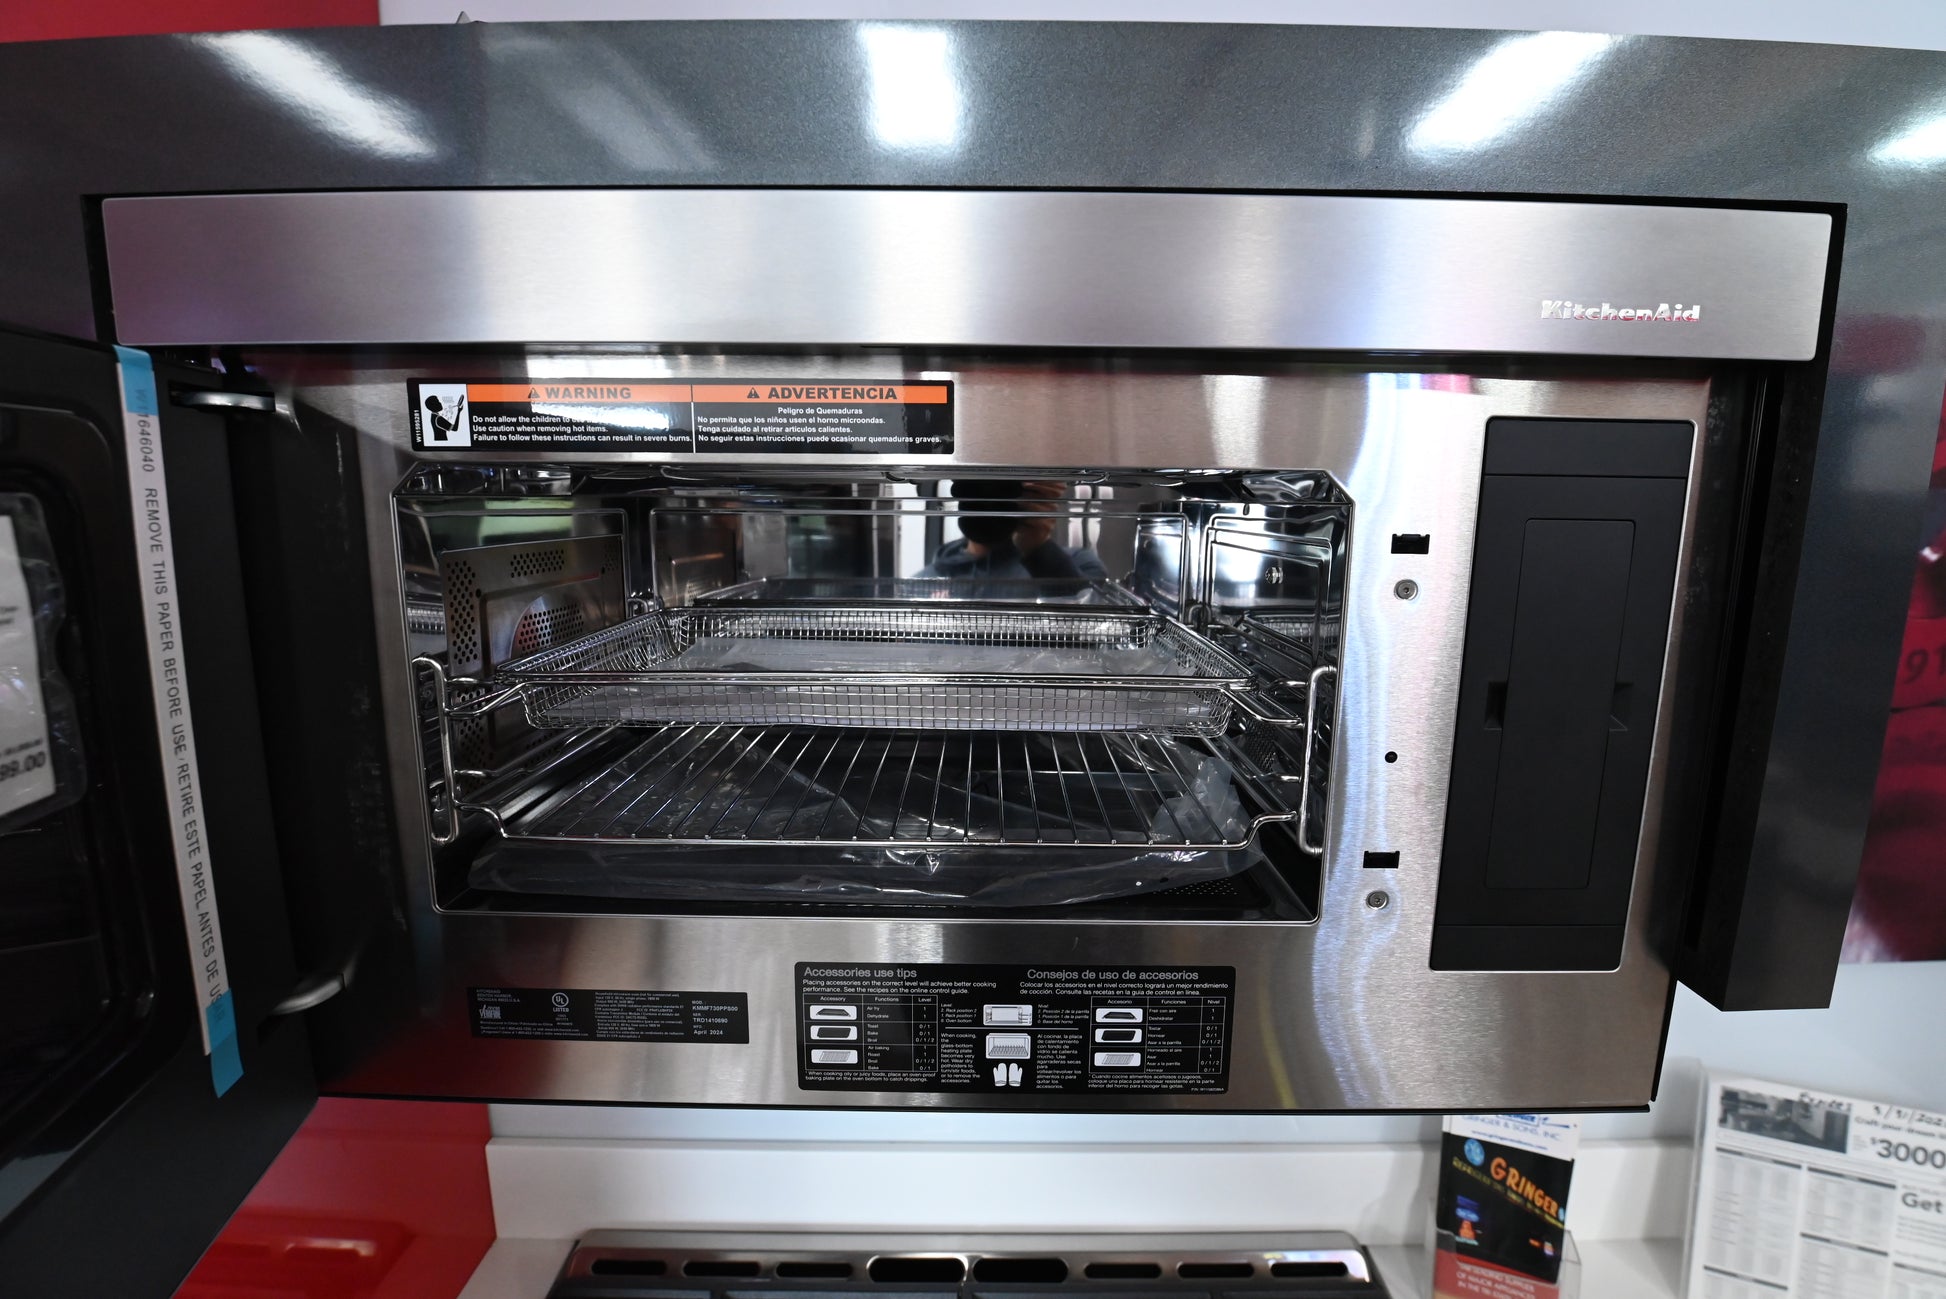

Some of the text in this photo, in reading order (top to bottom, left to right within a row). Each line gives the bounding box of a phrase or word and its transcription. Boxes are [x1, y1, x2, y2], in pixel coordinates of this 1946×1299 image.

[1541, 300, 1701, 322] KitchenAid
[545, 387, 632, 399] WARNING
[767, 387, 898, 400] ADVERTENCIA
[709, 416, 737, 425] permita
[777, 407, 804, 415] Peligro
[816, 407, 863, 416] Quemaduras
[537, 425, 571, 434] removing
[698, 426, 720, 434] Tenga
[710, 434, 734, 443] seguir
[806, 435, 830, 444] puede
[868, 436, 914, 444] quemaduras
[144, 487, 164, 552] REMOVE
[152, 560, 168, 595] THIS
[158, 602, 174, 652] PAPER
[163, 657, 182, 719] BEFORE
[172, 724, 187, 756] USE
[177, 762, 195, 818] RETIRE
[184, 819, 201, 860] ESTE
[191, 861, 207, 910] PAPEL
[198, 911, 216, 958] ANTES
[206, 960, 219, 983] DE
[804, 966, 917, 980] Accessories use tips
[1027, 969, 1199, 981] Consejos de uso de accesorios
[1491, 1157, 1558, 1218] GRINGER
[1902, 1192, 1944, 1215] Get
